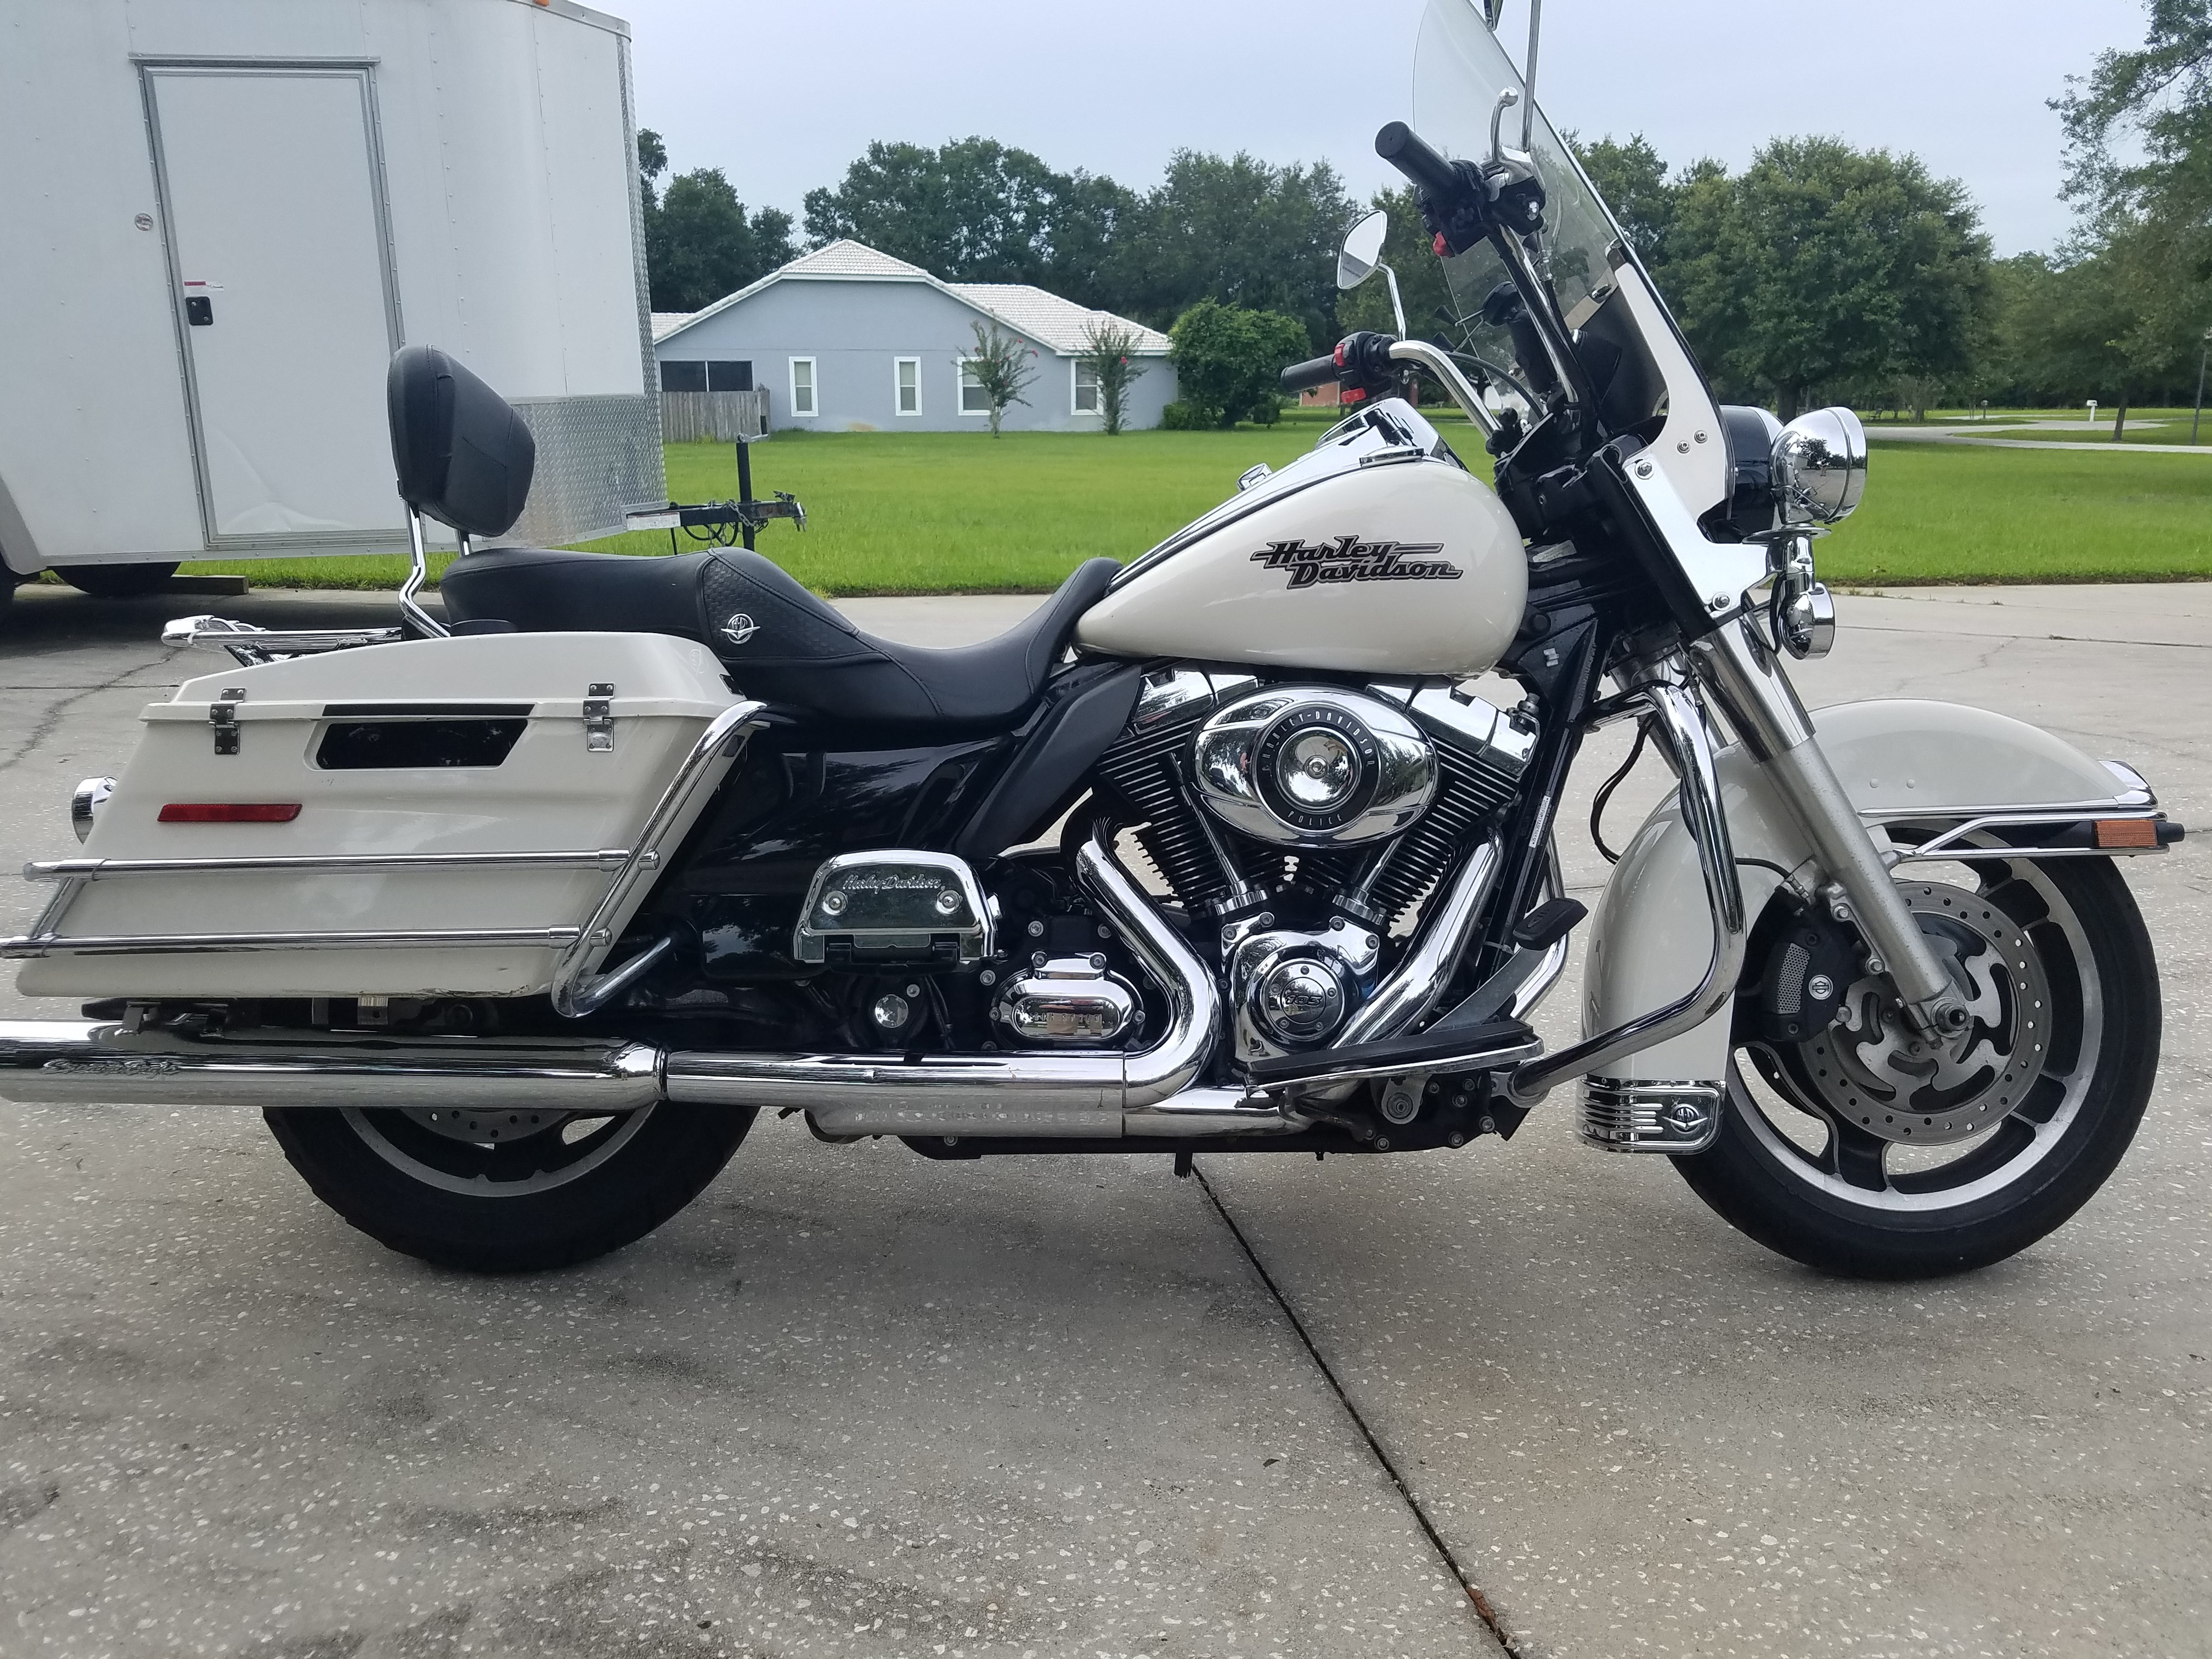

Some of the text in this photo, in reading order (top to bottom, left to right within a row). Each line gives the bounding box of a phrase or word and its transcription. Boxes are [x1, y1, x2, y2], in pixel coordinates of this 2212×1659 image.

[1250, 535, 1444, 569] Harley
[1285, 553, 1463, 590] Davidson
[1262, 711, 1375, 765] HARLEY-DAVIDSON
[1288, 810, 1342, 826] POLICE
[1285, 994, 1323, 1006] 103
